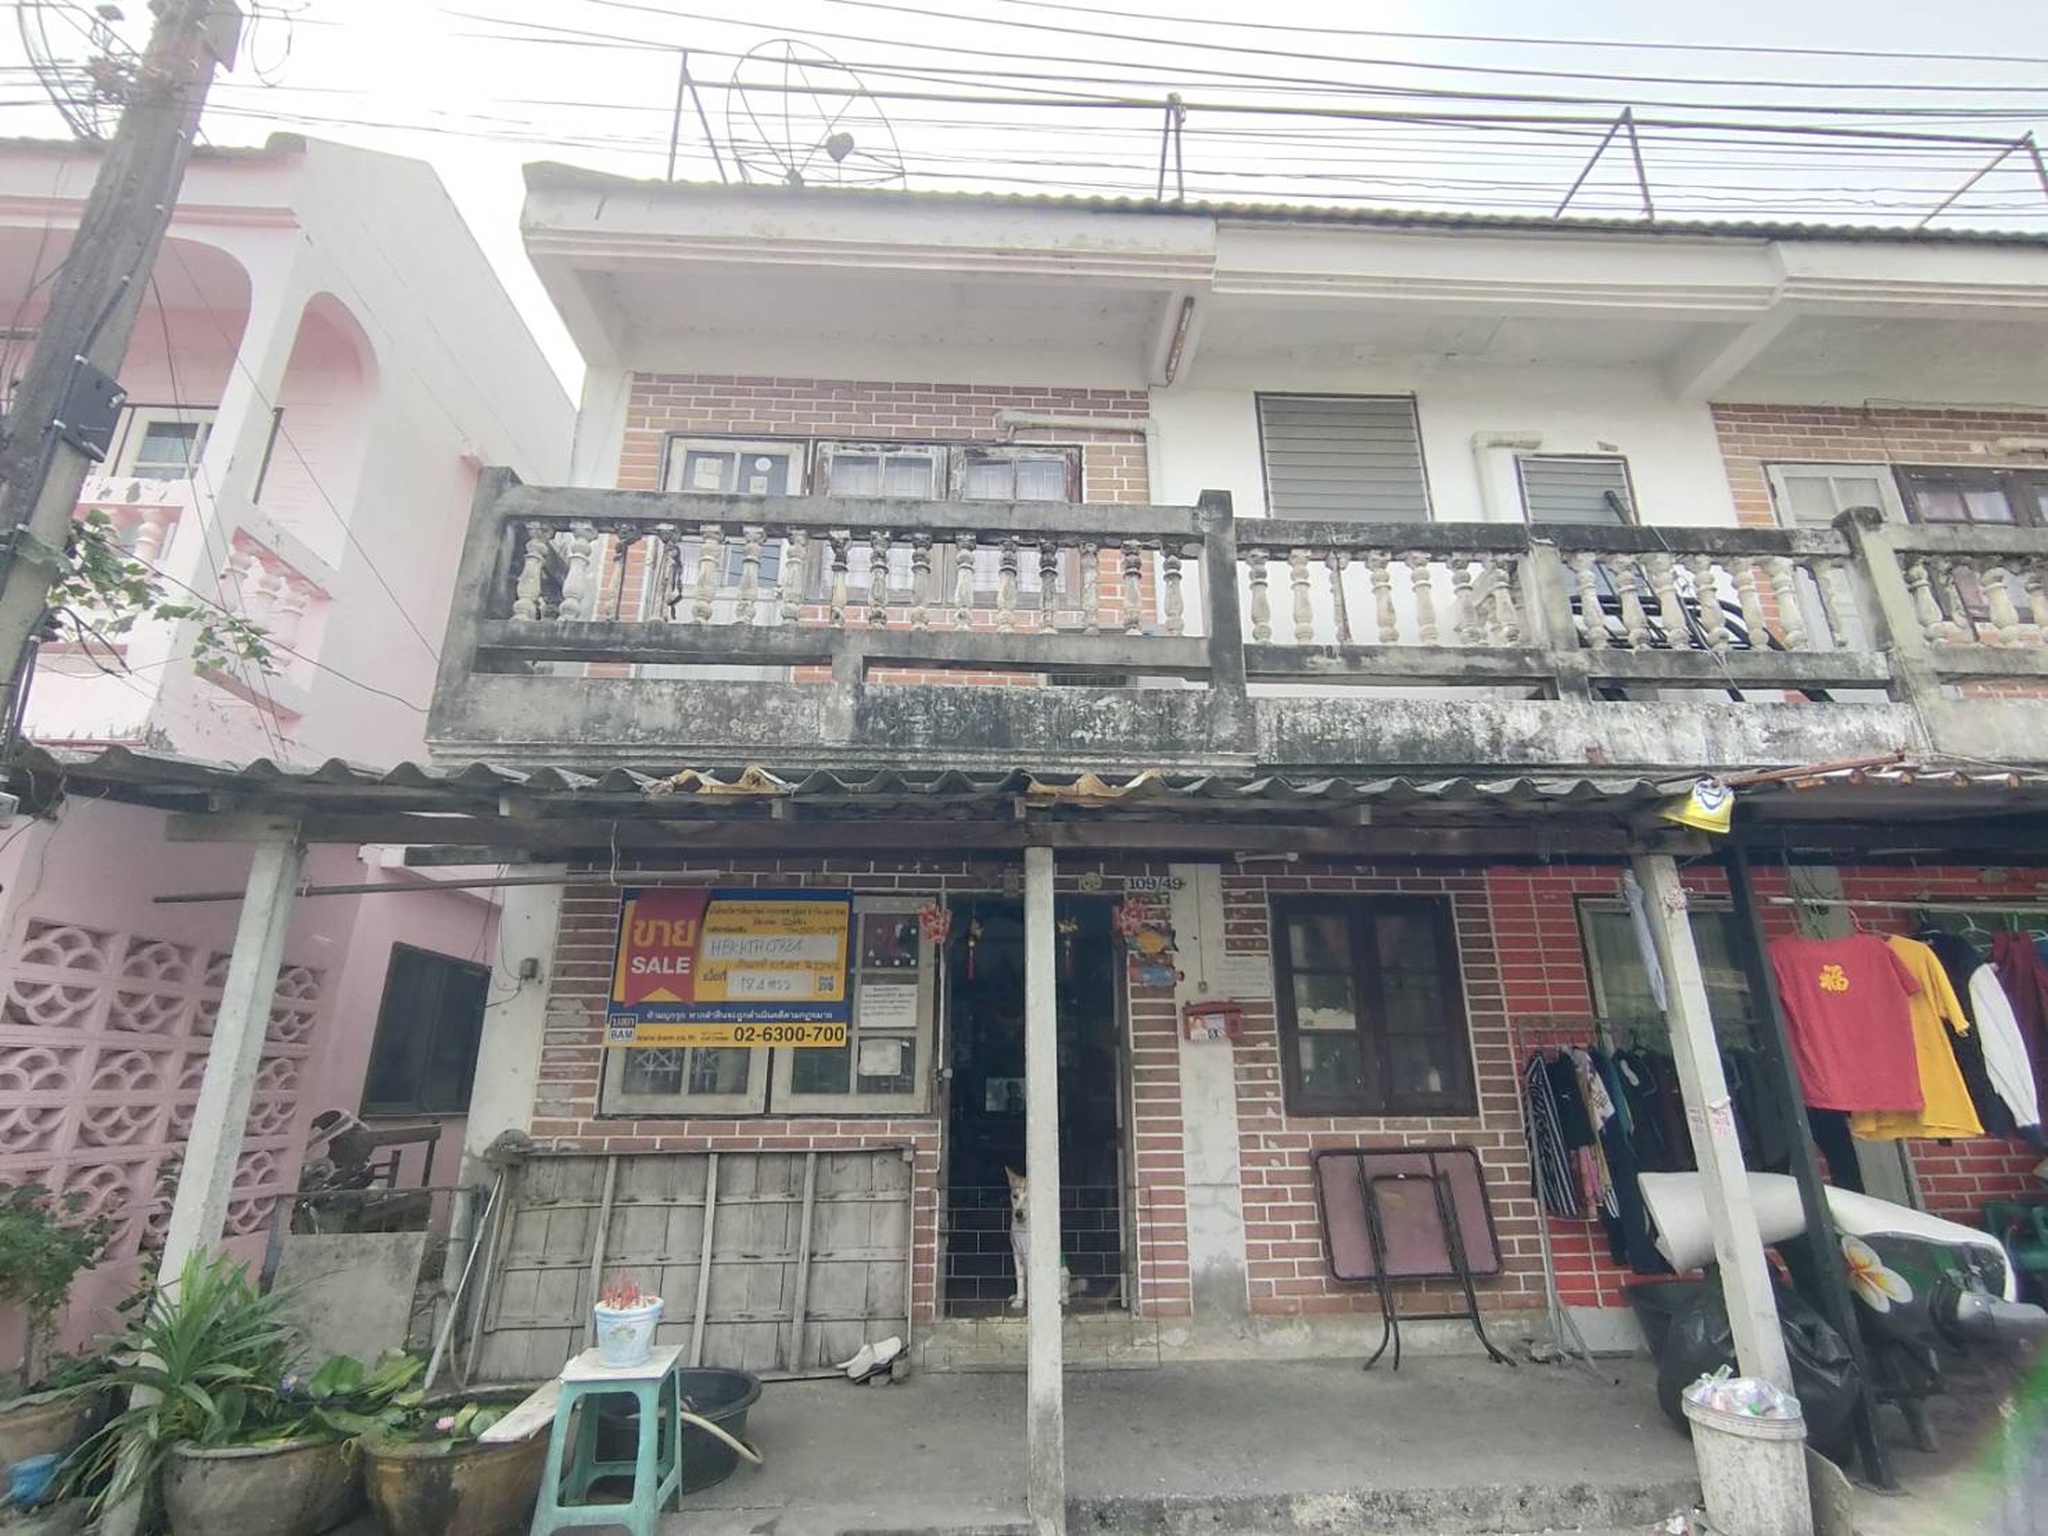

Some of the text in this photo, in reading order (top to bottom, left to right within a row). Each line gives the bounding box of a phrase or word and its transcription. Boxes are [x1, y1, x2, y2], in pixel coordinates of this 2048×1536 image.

[633, 919, 696, 948] ขาย
[631, 955, 691, 975] SALE
[610, 1029, 634, 1040] BAM
[734, 1026, 845, 1042] 02-6300-700
